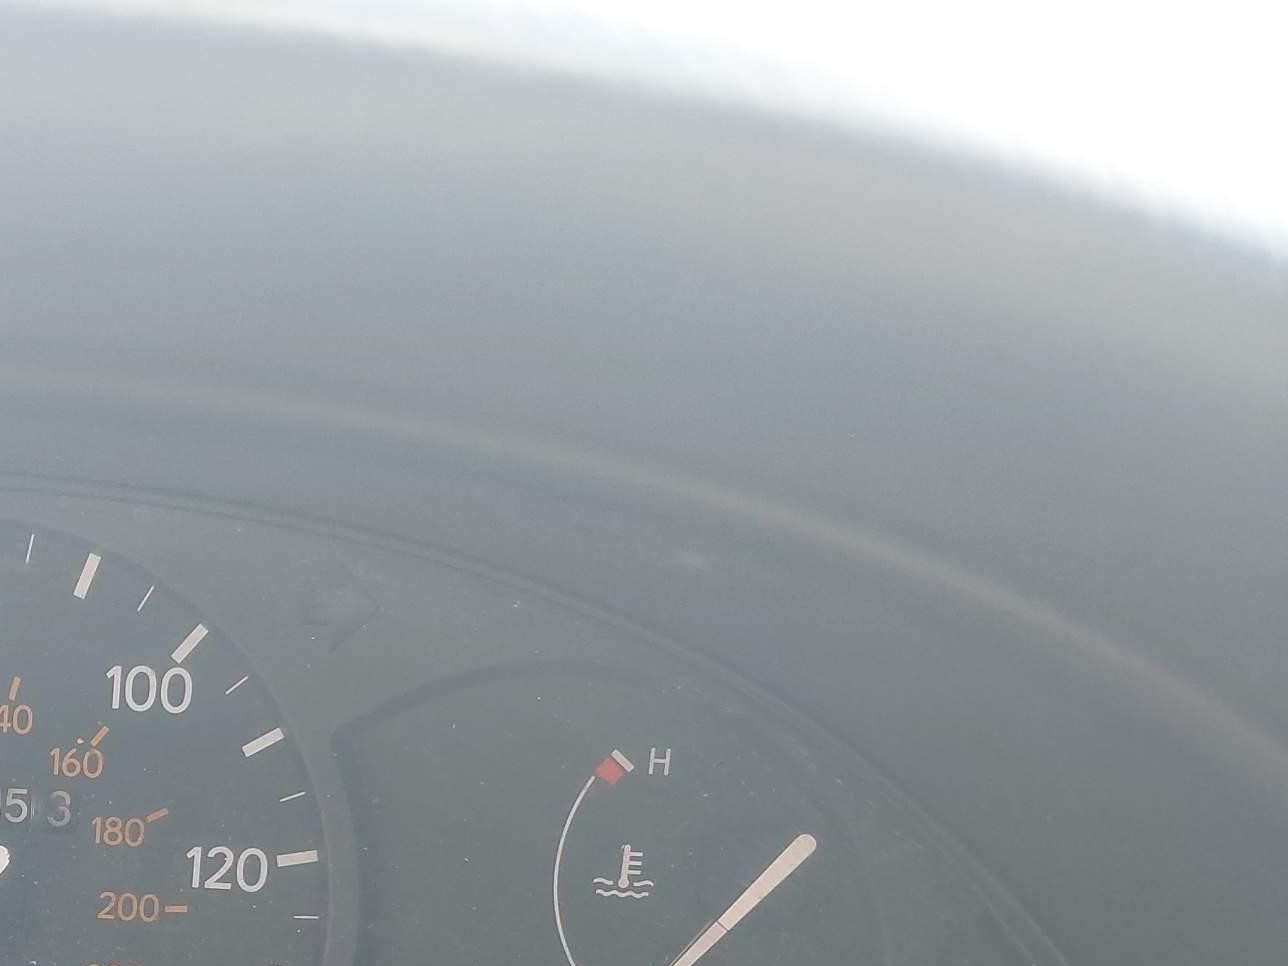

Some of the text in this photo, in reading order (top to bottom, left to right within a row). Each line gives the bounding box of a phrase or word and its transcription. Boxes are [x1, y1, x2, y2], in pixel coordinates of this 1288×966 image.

[106, 665, 193, 713] 100
[49, 749, 104, 778] 160
[648, 748, 671, 775] H
[91, 816, 145, 846] 180
[186, 846, 268, 892] 120
[97, 892, 160, 922] 200
